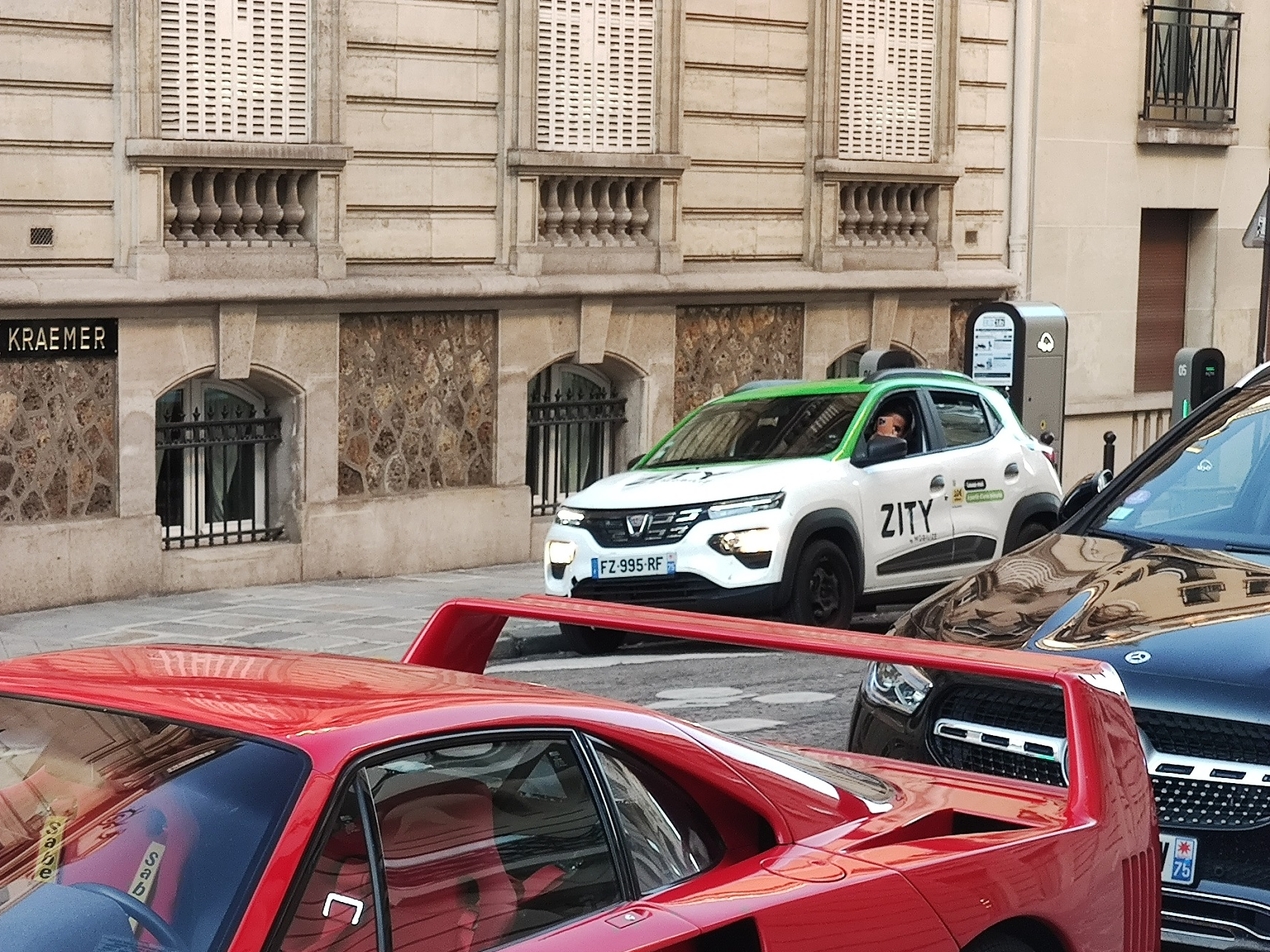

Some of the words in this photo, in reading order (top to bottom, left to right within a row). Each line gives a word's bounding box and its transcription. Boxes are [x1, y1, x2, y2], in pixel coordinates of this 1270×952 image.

[8, 326, 106, 351] KRAEMER
[880, 499, 933, 538] ZITY
[600, 556, 664, 574] FZ-995-RF
[1173, 860, 1191, 878] 75
